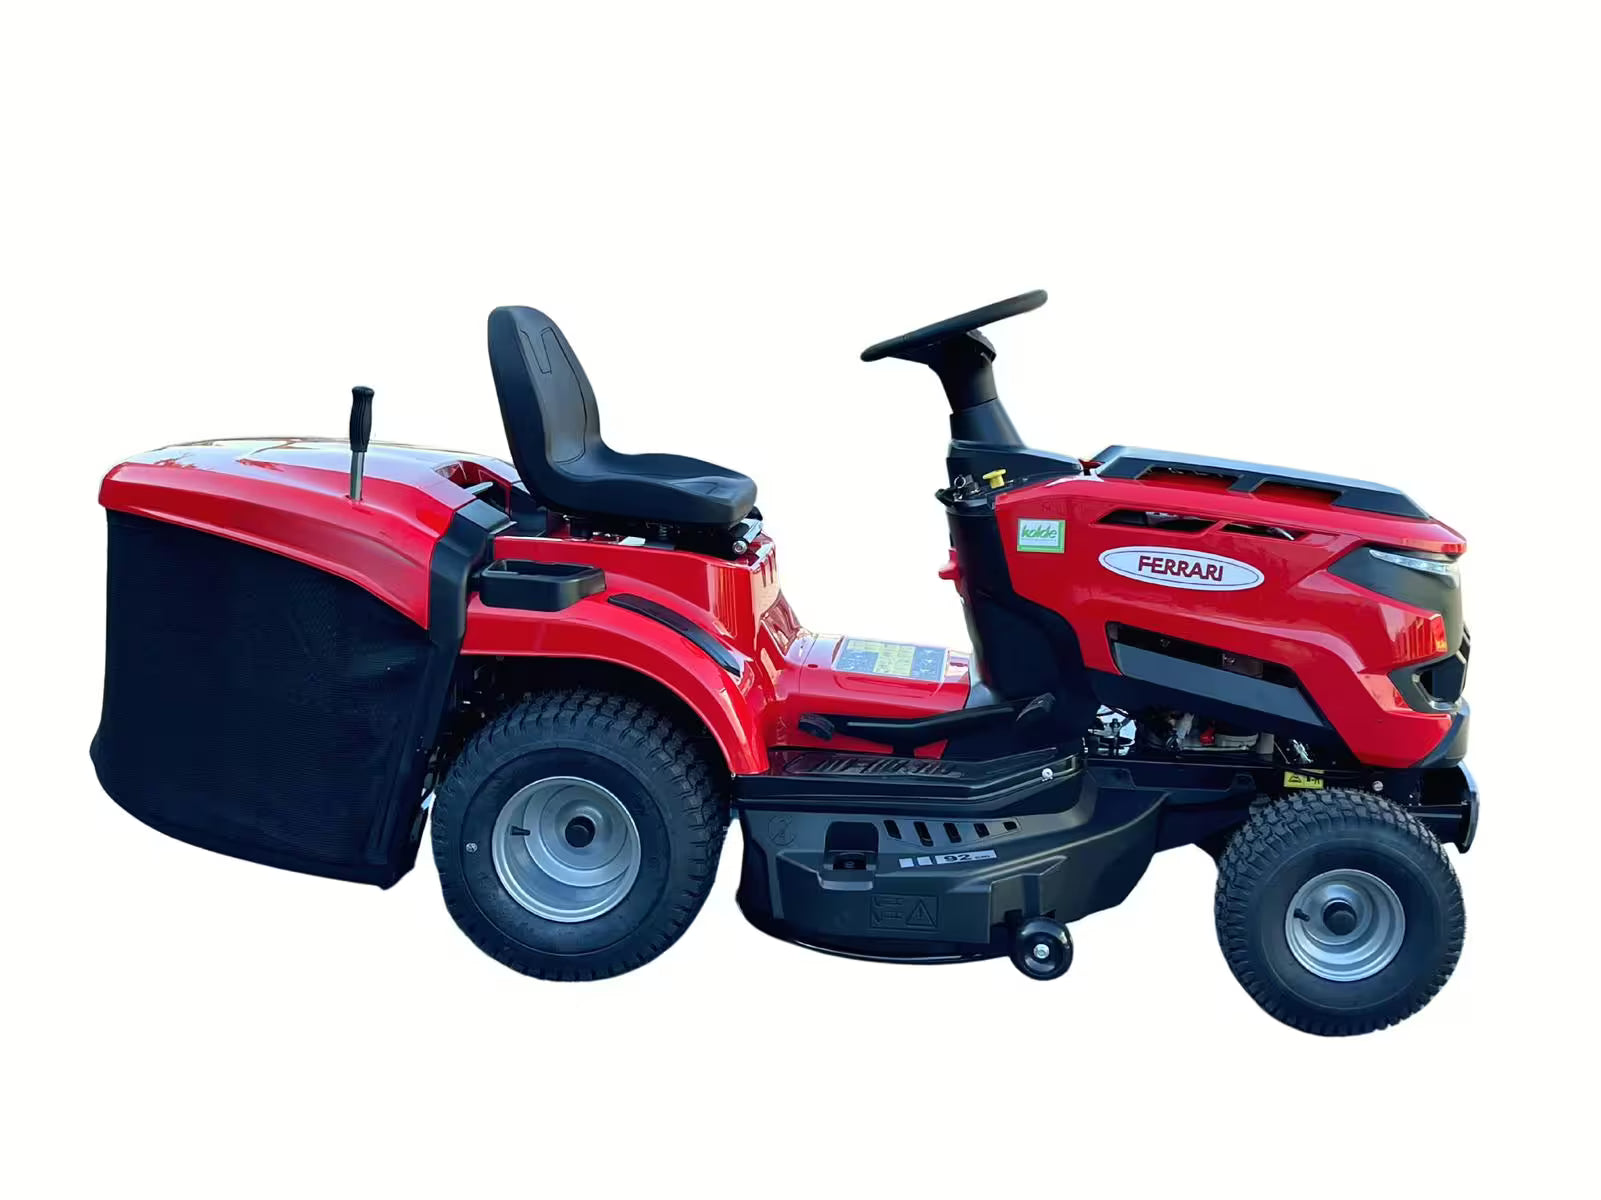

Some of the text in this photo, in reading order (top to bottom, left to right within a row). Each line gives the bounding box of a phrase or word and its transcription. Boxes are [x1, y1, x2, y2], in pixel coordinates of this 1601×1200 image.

[1021, 524, 1057, 539] kolde
[1138, 555, 1224, 582] FERRARI
[944, 853, 972, 862] 92
